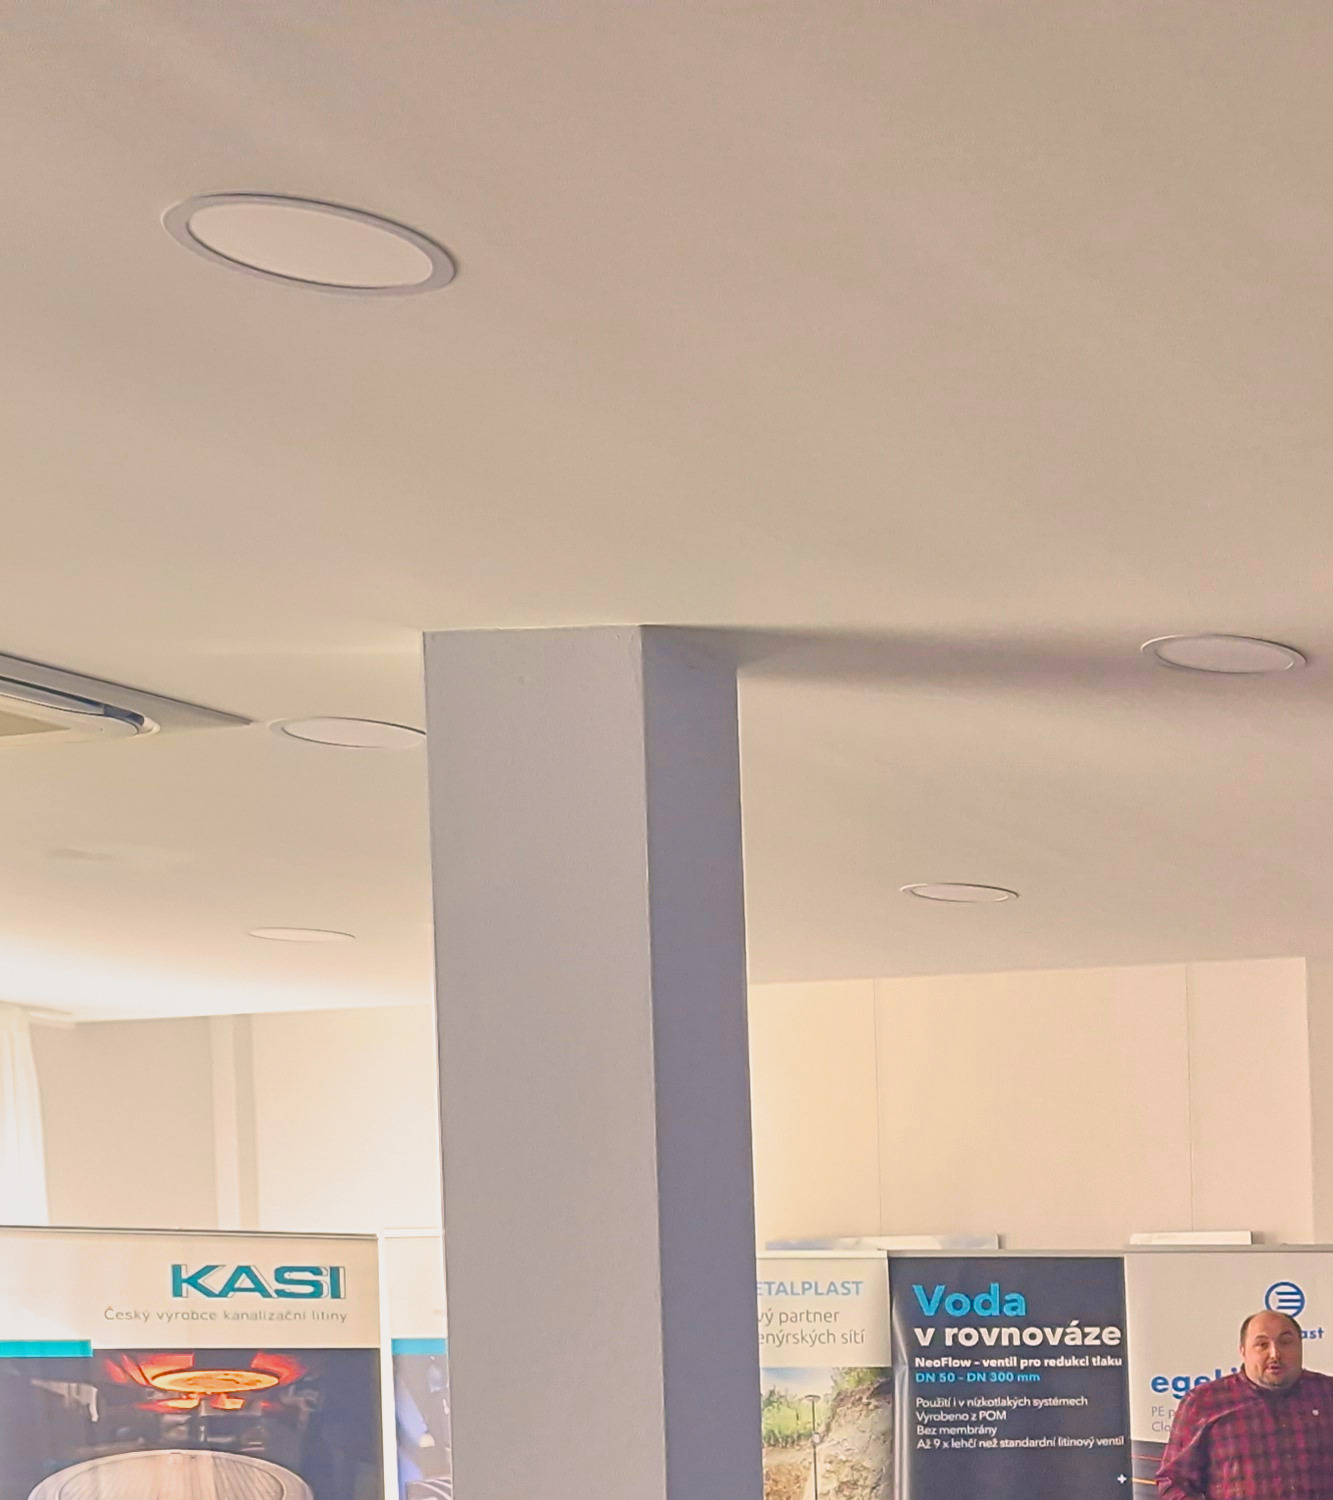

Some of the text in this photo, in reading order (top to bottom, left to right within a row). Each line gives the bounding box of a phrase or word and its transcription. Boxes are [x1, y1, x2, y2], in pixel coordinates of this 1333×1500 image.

[171, 1264, 346, 1299] KASI
[757, 1281, 863, 1296] ETALPLAST
[912, 1283, 1026, 1317] Voda
[103, 1305, 150, 1322] Český
[223, 1309, 306, 1321] kanalizační
[312, 1310, 347, 1323] litiny
[779, 1309, 840, 1326] partner
[758, 1328, 866, 1348] enýrských sítí
[914, 1320, 1121, 1346] v rovnováze
[915, 1357, 971, 1367] NeoFlow
[982, 1356, 1017, 1367] ventil
[1020, 1359, 1041, 1369] pro
[1044, 1356, 1089, 1367] redukci
[1092, 1356, 1122, 1367] tlaku
[915, 1373, 936, 1383] DN
[939, 1373, 956, 1383] 50
[967, 1372, 987, 1382] DN
[990, 1371, 1014, 1382] 300
[1017, 1374, 1041, 1382] mm
[916, 1396, 951, 1409] Použití
[916, 1411, 969, 1424] Vyrobeno
[979, 1411, 1007, 1421] POM
[1151, 1406, 1165, 1417] PE
[917, 1424, 997, 1437] Bez membrány
[917, 1438, 931, 1449] Až
[934, 1440, 940, 1449] 9
[979, 1437, 998, 1448] než
[1000, 1435, 1056, 1448] standardní
[1096, 1434, 1124, 1446] ventil
